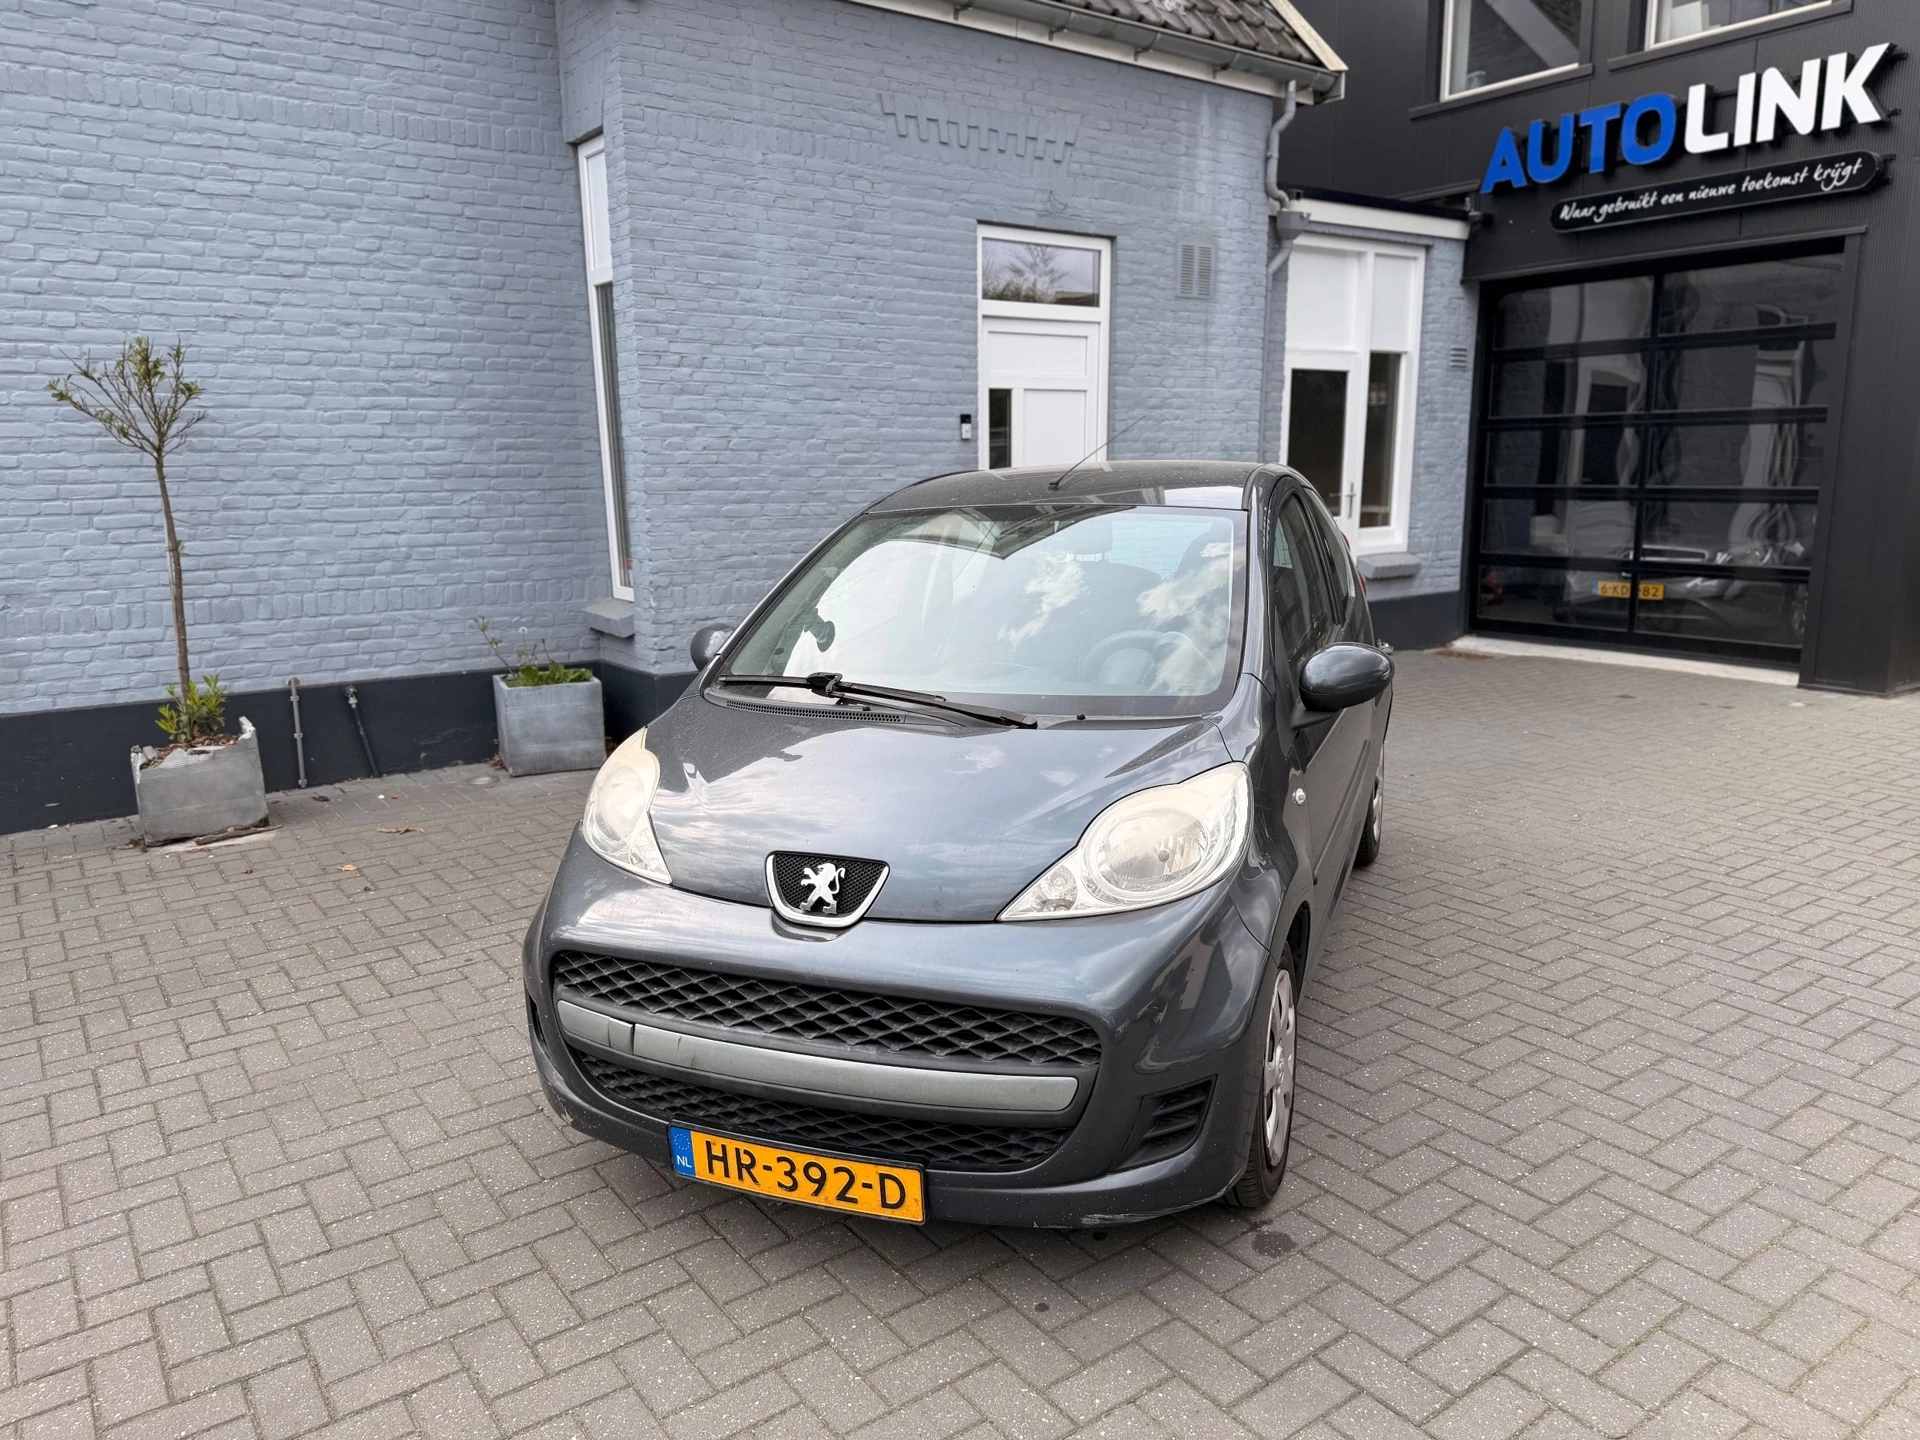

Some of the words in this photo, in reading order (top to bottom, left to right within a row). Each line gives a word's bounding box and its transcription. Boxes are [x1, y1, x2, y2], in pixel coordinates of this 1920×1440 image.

[1560, 202, 1596, 220] Waar
[1593, 190, 1658, 223] gebruikt
[1660, 192, 1684, 205] een
[1688, 185, 1736, 200] nieuwe
[1741, 166, 1808, 193] toekomst
[1601, 584, 1660, 598] 6-KD-82
[676, 1154, 692, 1169] NL
[705, 1139, 906, 1210] HR-392-D
